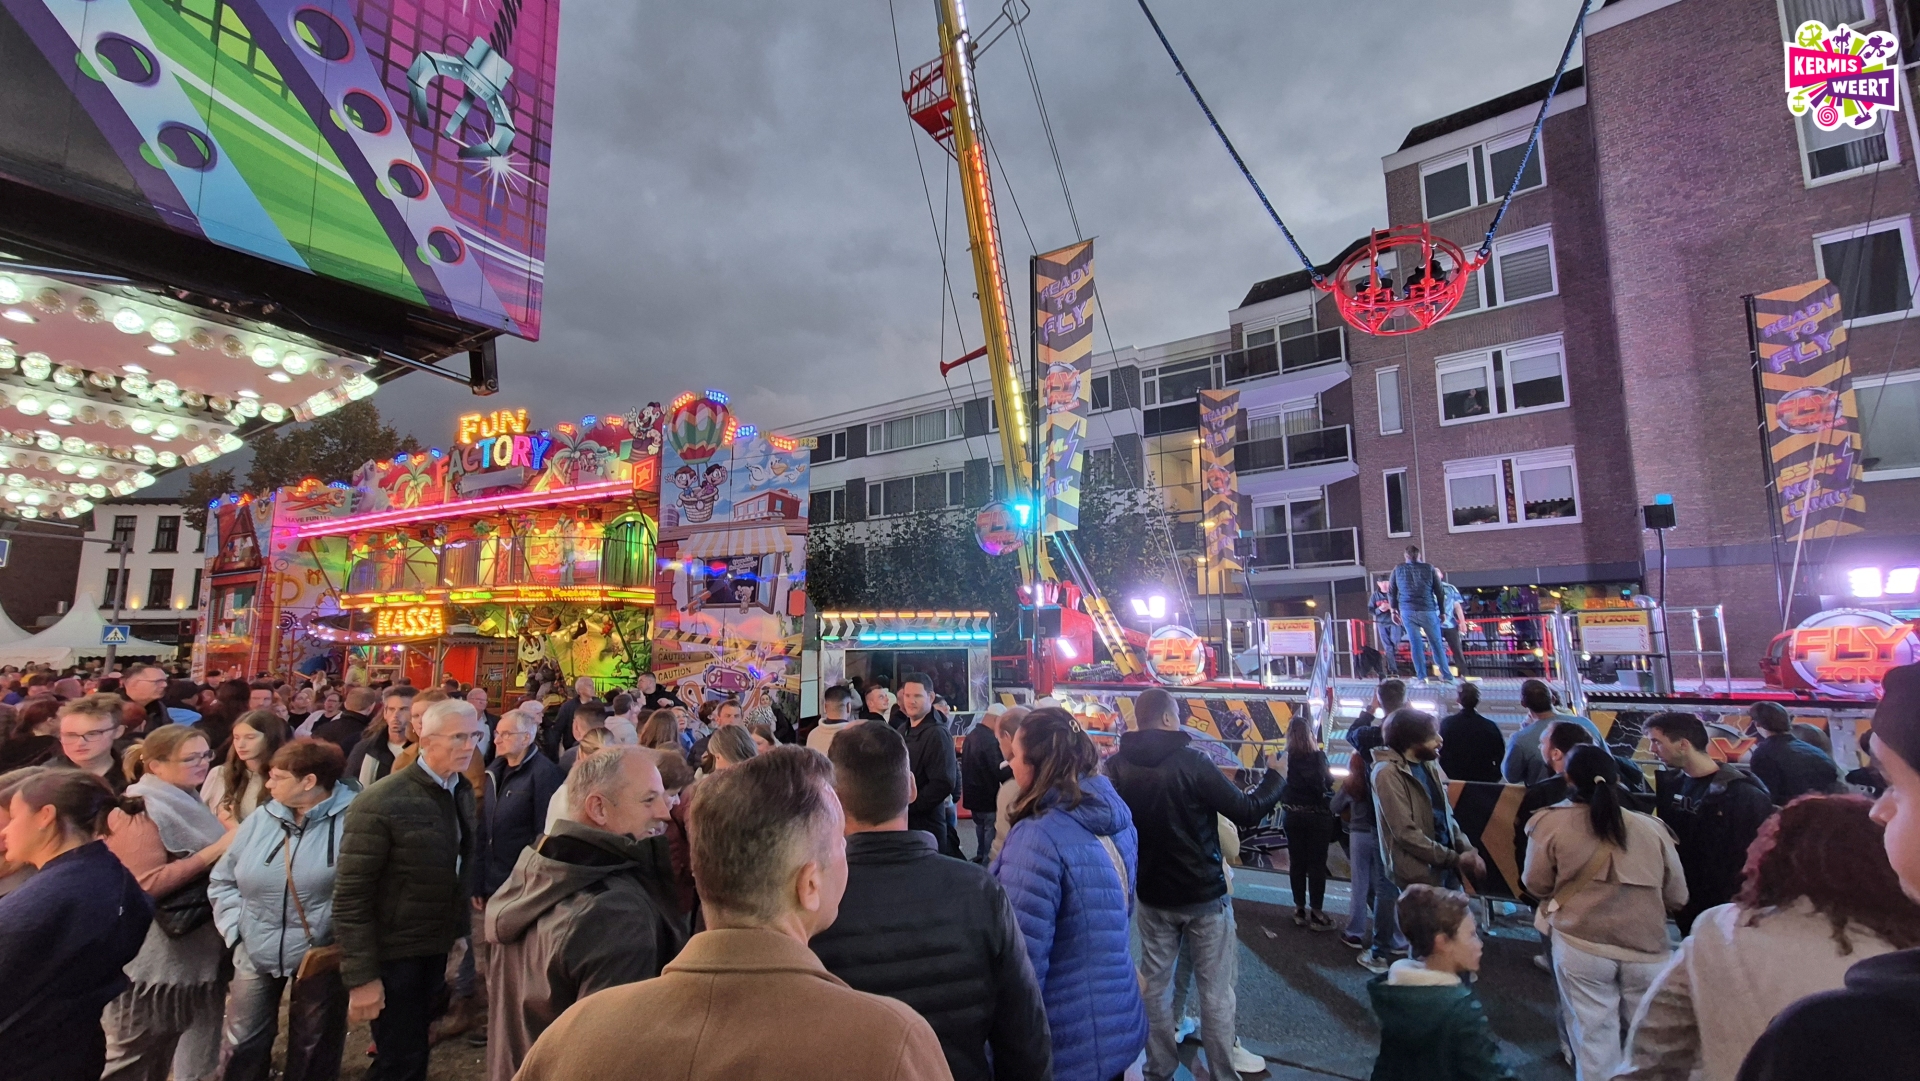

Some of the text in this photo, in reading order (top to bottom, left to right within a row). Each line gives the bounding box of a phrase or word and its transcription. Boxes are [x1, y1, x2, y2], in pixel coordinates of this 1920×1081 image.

[1041, 260, 1092, 303] READY
[1055, 288, 1077, 311] TO
[1043, 299, 1088, 344] FLY
[1763, 293, 1837, 339] READY
[1788, 319, 1820, 343] TO
[1770, 329, 1836, 374] FLY
[459, 408, 527, 445] FUN
[436, 434, 551, 489] FACTORY
[519, 587, 600, 599] Fun Factory
[377, 606, 444, 636] KASSA
[658, 653, 692, 661] CAUTION
[1146, 636, 1202, 662] FLY
[1793, 623, 1915, 662] FLY
[658, 667, 692, 681] CAUTION
[1156, 663, 1197, 677] ZONE
